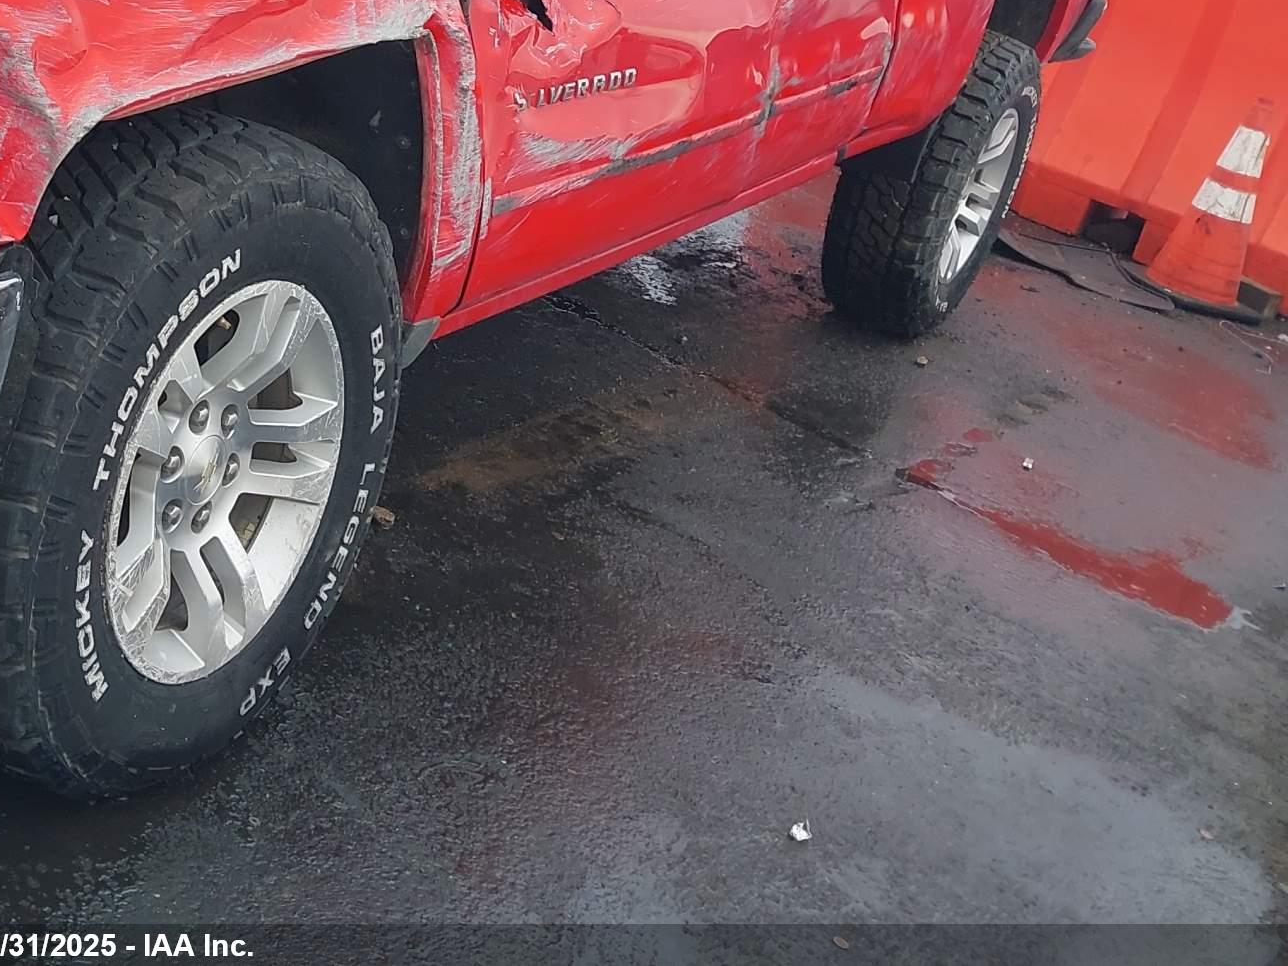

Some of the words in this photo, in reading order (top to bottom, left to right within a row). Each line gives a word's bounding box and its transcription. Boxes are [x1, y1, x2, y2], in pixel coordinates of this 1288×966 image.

[513, 67, 638, 113] SLVERADO
[92, 247, 242, 491] THOMPSON
[370, 323, 386, 435] BAJA
[75, 529, 110, 703] MICKEY
[303, 462, 376, 630] LEGEND
[239, 646, 292, 717] EXP
